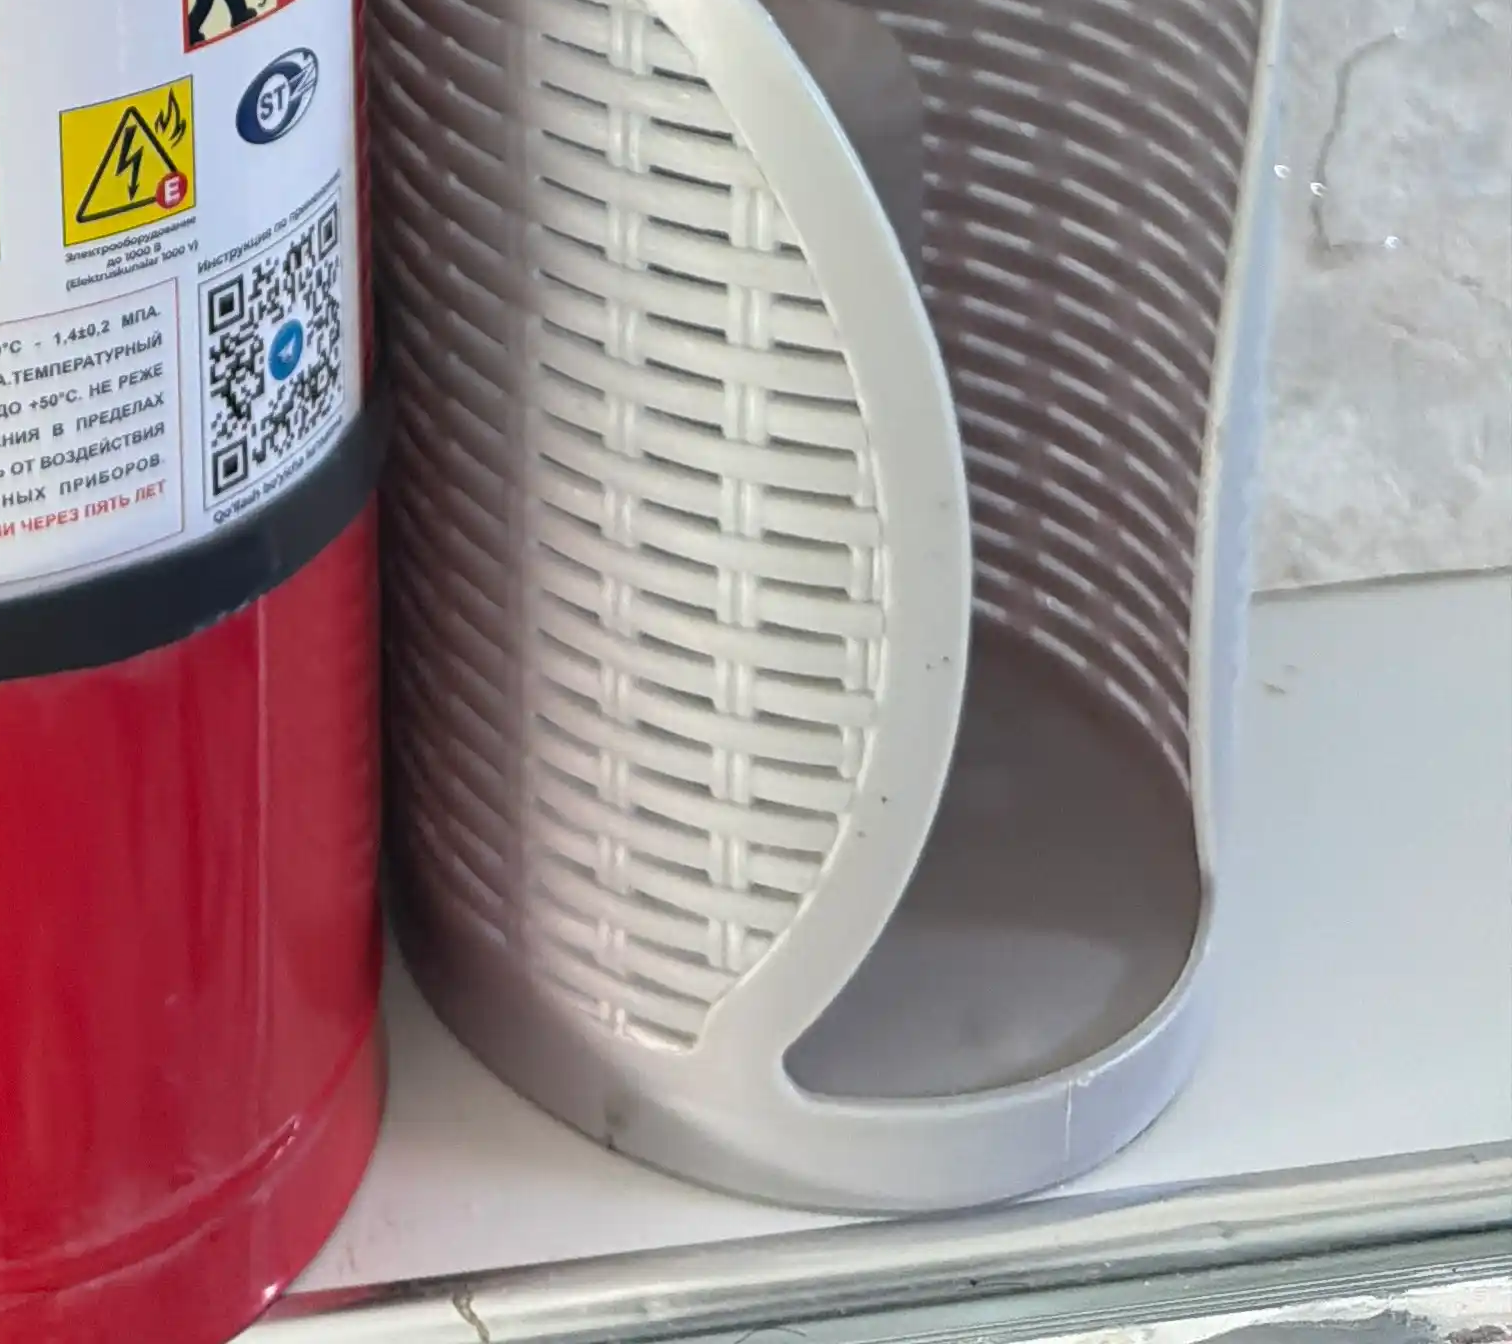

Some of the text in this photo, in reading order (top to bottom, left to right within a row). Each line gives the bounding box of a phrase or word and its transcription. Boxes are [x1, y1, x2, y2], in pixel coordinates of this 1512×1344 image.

[164, 178, 181, 203] E
[54, 319, 110, 345] 1,4±0,2
[122, 305, 160, 329] МПА.
[21, 508, 79, 532] ЧЕРЕЗ
[85, 495, 130, 518] ПЯТЬ
[136, 478, 165, 504] ЛЕТ
